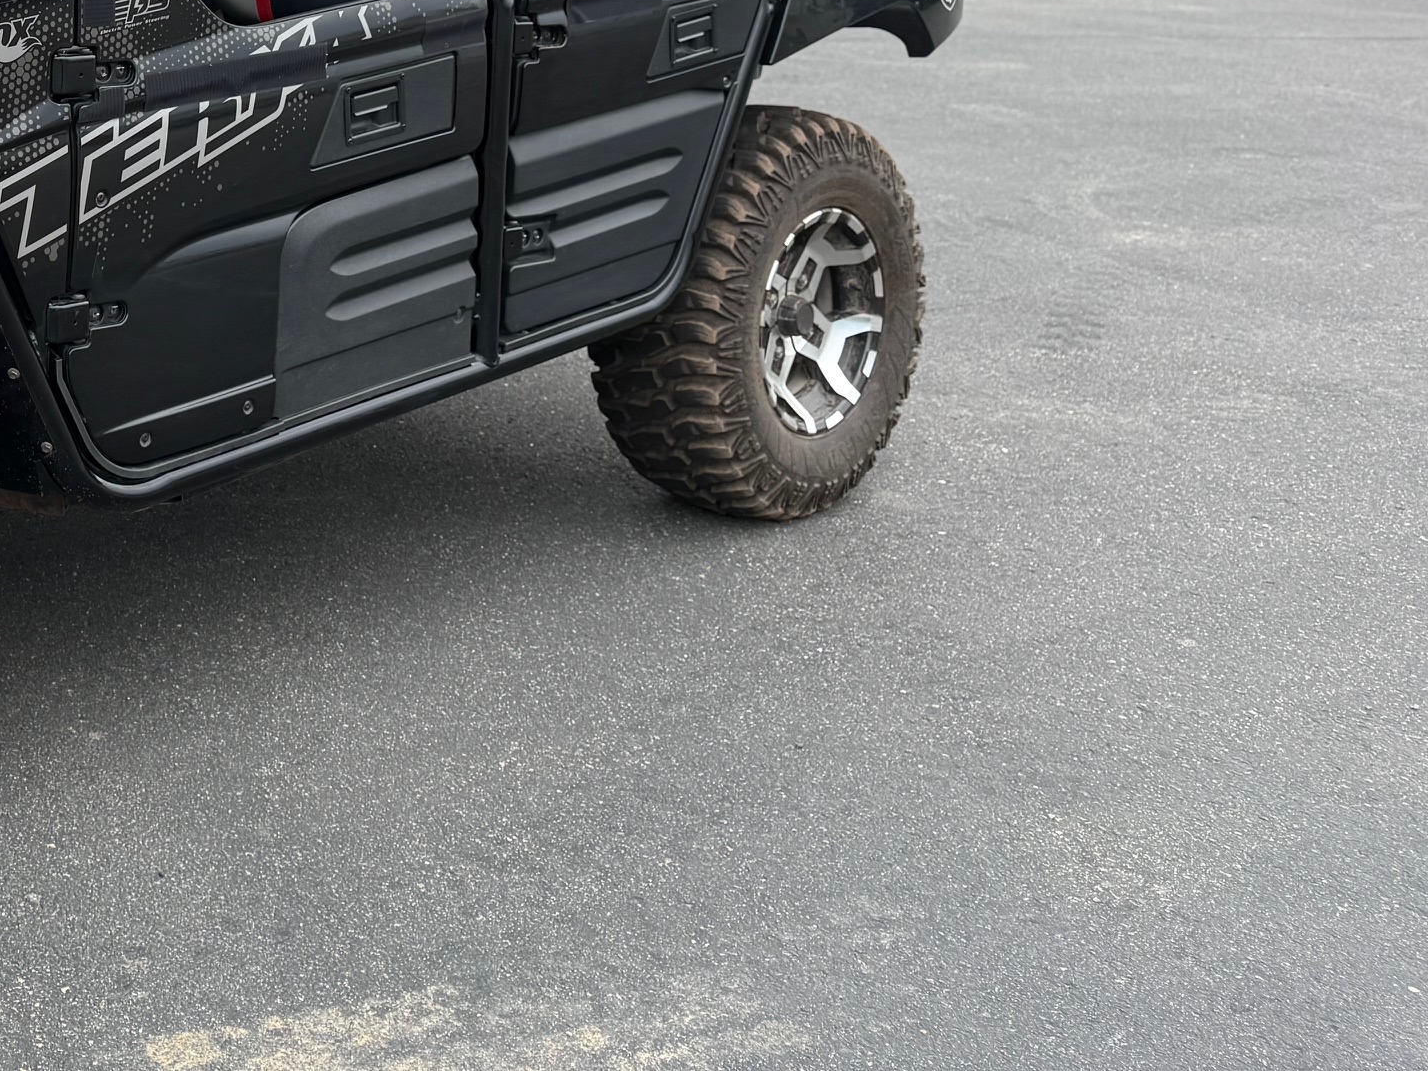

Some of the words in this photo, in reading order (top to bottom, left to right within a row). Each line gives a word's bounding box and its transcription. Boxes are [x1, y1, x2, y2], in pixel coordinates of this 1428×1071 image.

[100, 25, 122, 35] Electric
[124, 20, 143, 29] Power
[145, 14, 170, 24] Steering
